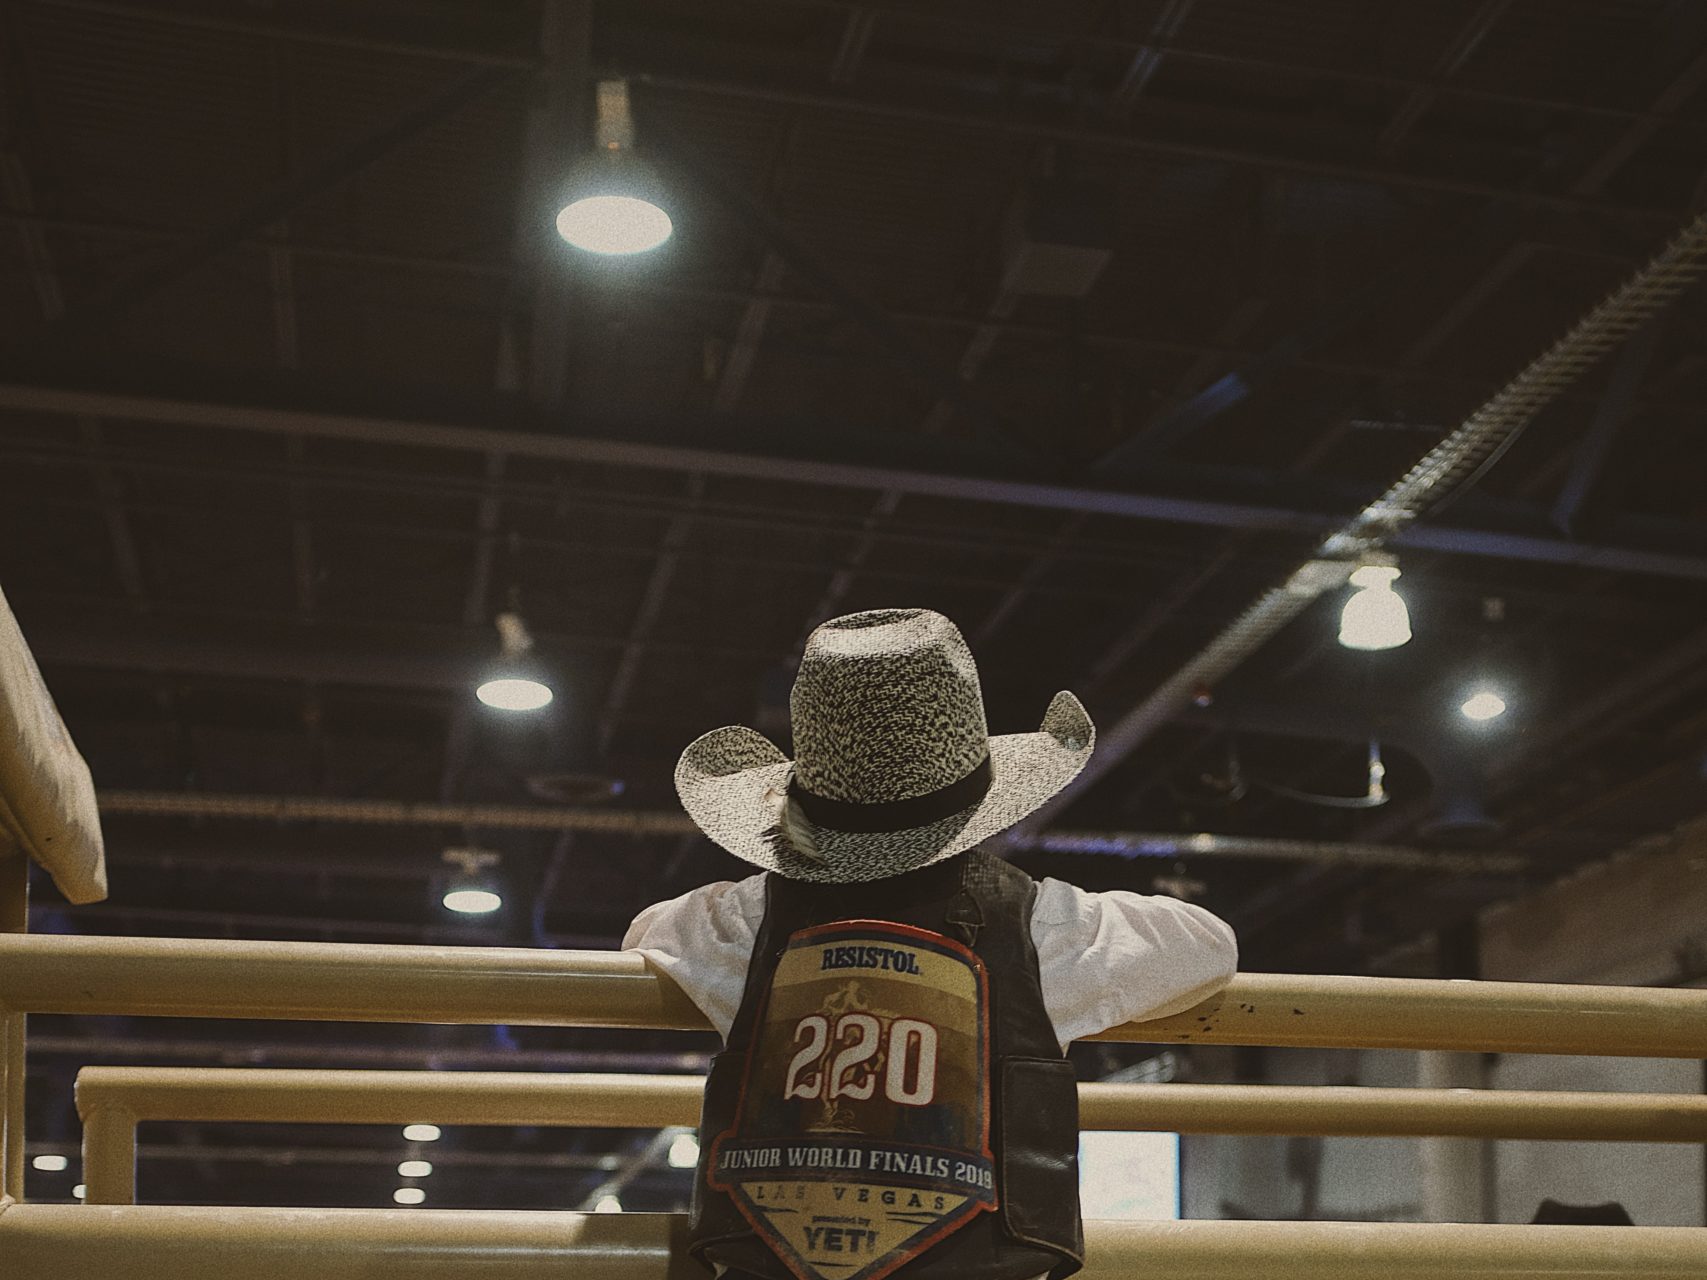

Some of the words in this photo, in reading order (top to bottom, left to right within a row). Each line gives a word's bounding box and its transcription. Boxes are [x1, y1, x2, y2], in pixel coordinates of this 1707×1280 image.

[821, 946, 919, 975] RESISTOL
[784, 1013, 937, 1105] 220
[720, 1148, 781, 1169] JUNIOR
[787, 1147, 862, 1169] WORLD
[869, 1151, 949, 1178] FINALS
[757, 1185, 805, 1200] LAS
[833, 1187, 945, 1210] VEGAS
[803, 1226, 879, 1252] YETI
